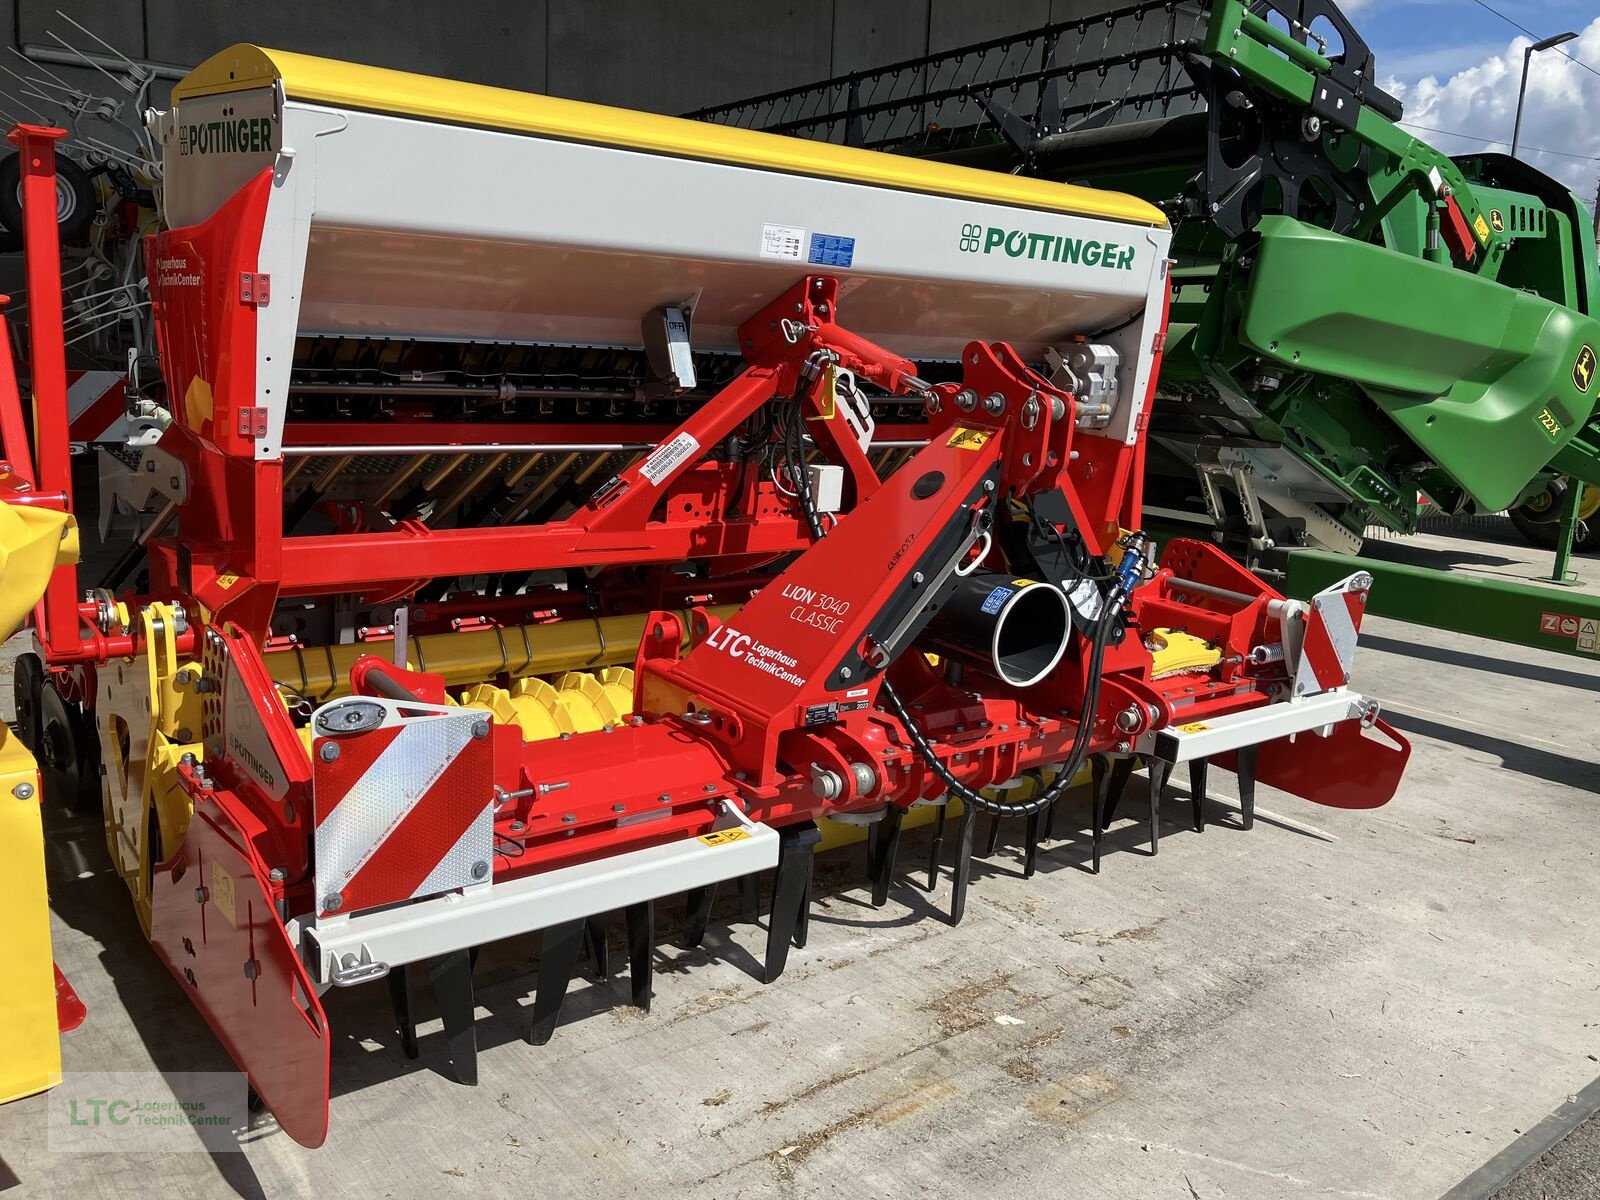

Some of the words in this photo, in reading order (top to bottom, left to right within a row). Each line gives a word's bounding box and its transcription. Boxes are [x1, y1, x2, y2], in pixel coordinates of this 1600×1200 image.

[189, 117, 272, 155] PÖTTINGER
[983, 227, 1135, 270] PÖTTINGER
[781, 583, 816, 605] LION
[813, 593, 850, 616] 3040
[789, 605, 844, 634] CLASSIC
[705, 624, 752, 658] LTC
[751, 640, 798, 668] Lagerhaus
[743, 652, 806, 687] TechnikCenter
